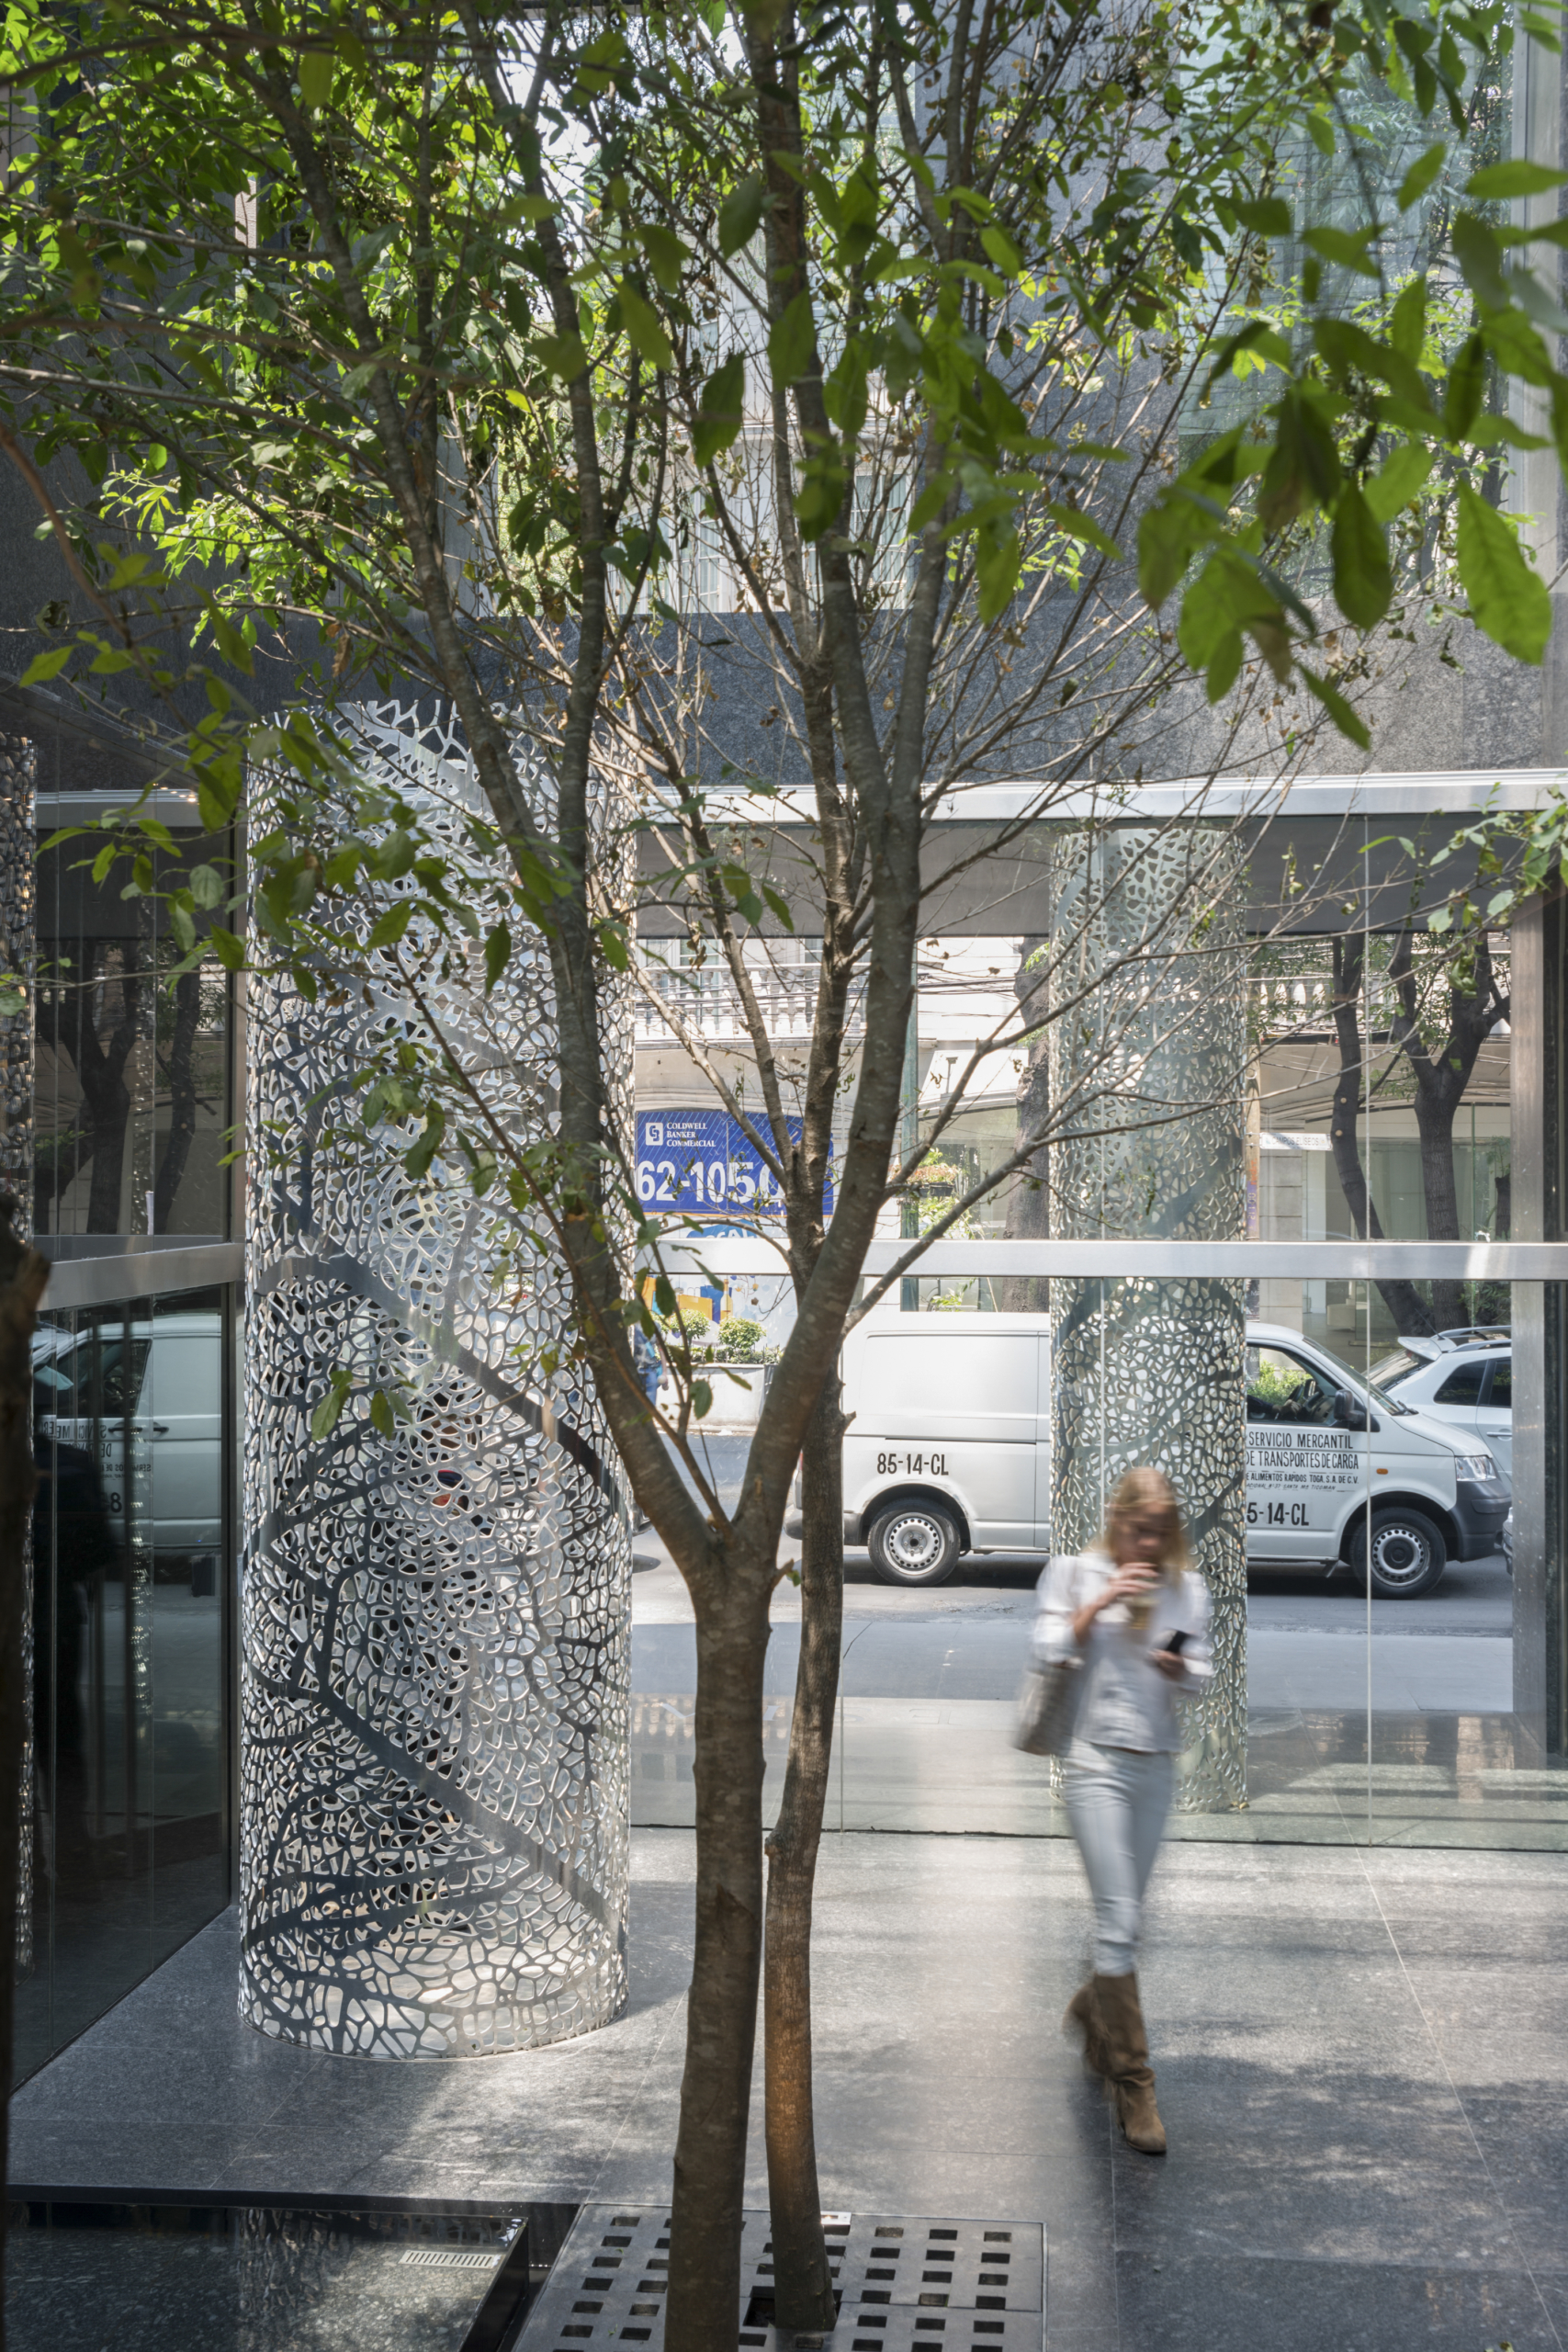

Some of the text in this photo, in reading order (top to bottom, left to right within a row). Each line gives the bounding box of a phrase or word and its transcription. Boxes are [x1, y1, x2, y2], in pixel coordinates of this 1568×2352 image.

[666, 1139, 716, 1148] COMMERCIAL
[1248, 1431, 1354, 1449] SERVICIO MERCANTIL
[876, 1453, 949, 1476] 85-14-CL
[1258, 1451, 1321, 1468] TRANSPORTES
[1321, 1453, 1331, 1468] DE
[1332, 1453, 1359, 1470] CARGA
[1250, 1473, 1283, 1482] ALIMENTOS
[1284, 1473, 1307, 1483] RAPIDOS
[1338, 1476, 1347, 1484] DE
[1247, 1502, 1310, 1527] 5-14-CL
